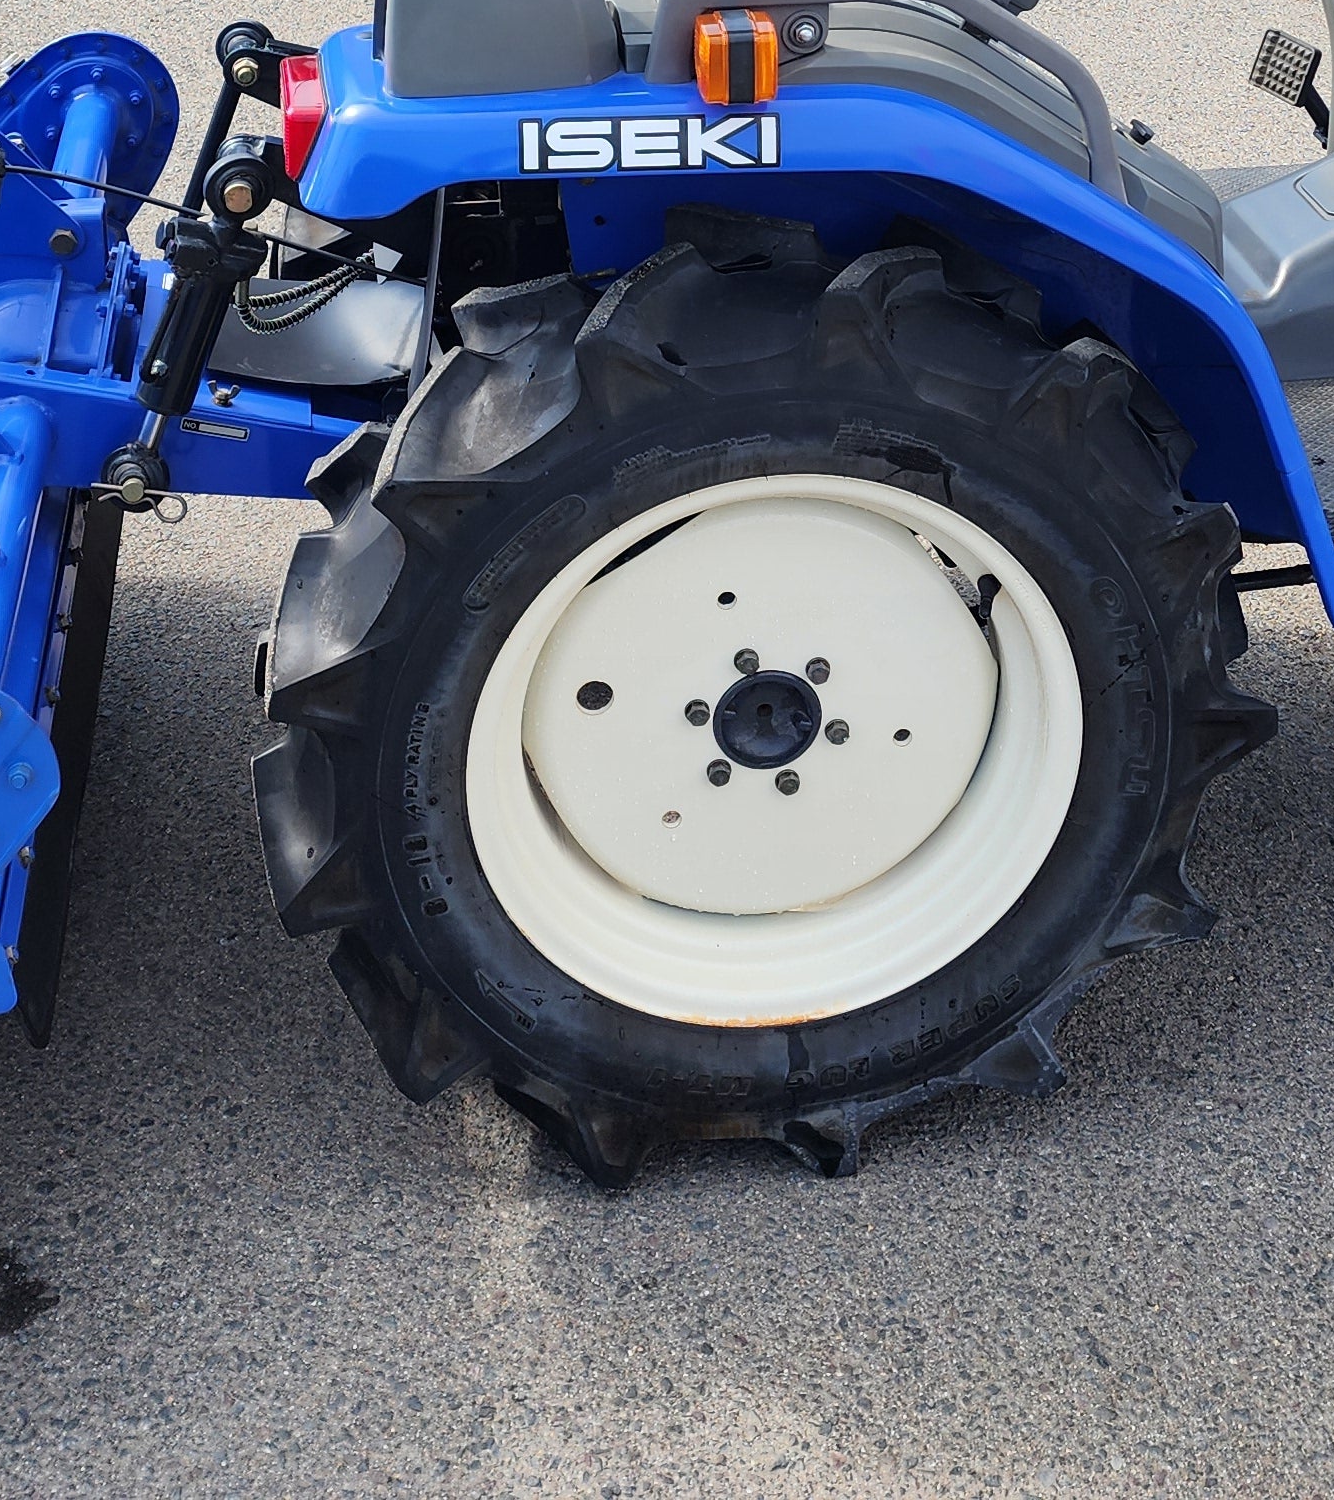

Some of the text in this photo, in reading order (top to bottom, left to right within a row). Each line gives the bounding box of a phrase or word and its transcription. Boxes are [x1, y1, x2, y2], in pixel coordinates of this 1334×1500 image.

[519, 113, 780, 174] ISEKI
[406, 701, 430, 765] RATING
[405, 770, 424, 800] PLY
